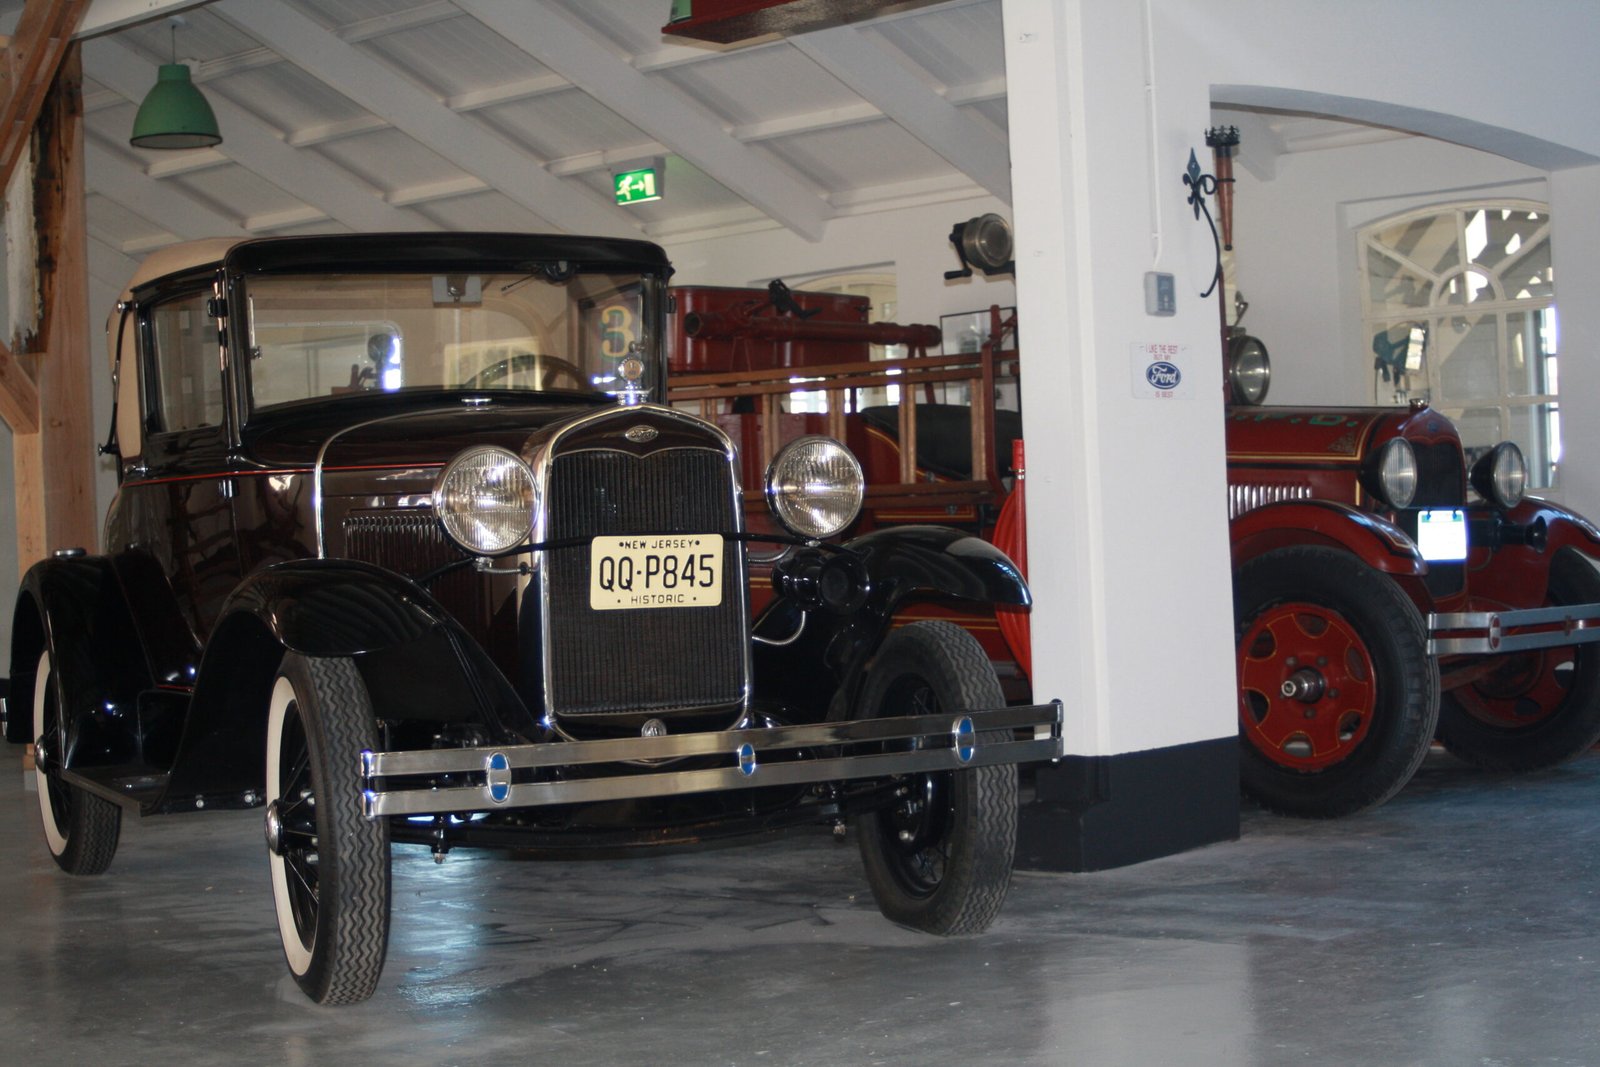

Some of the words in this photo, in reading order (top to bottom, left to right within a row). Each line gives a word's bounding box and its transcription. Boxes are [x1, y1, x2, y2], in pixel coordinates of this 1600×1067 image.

[602, 305, 634, 357] 3
[1151, 365, 1178, 384] Ford
[625, 541, 647, 549] NEW
[651, 539, 694, 549] JERSEY
[631, 594, 685, 604] HISTORIC
